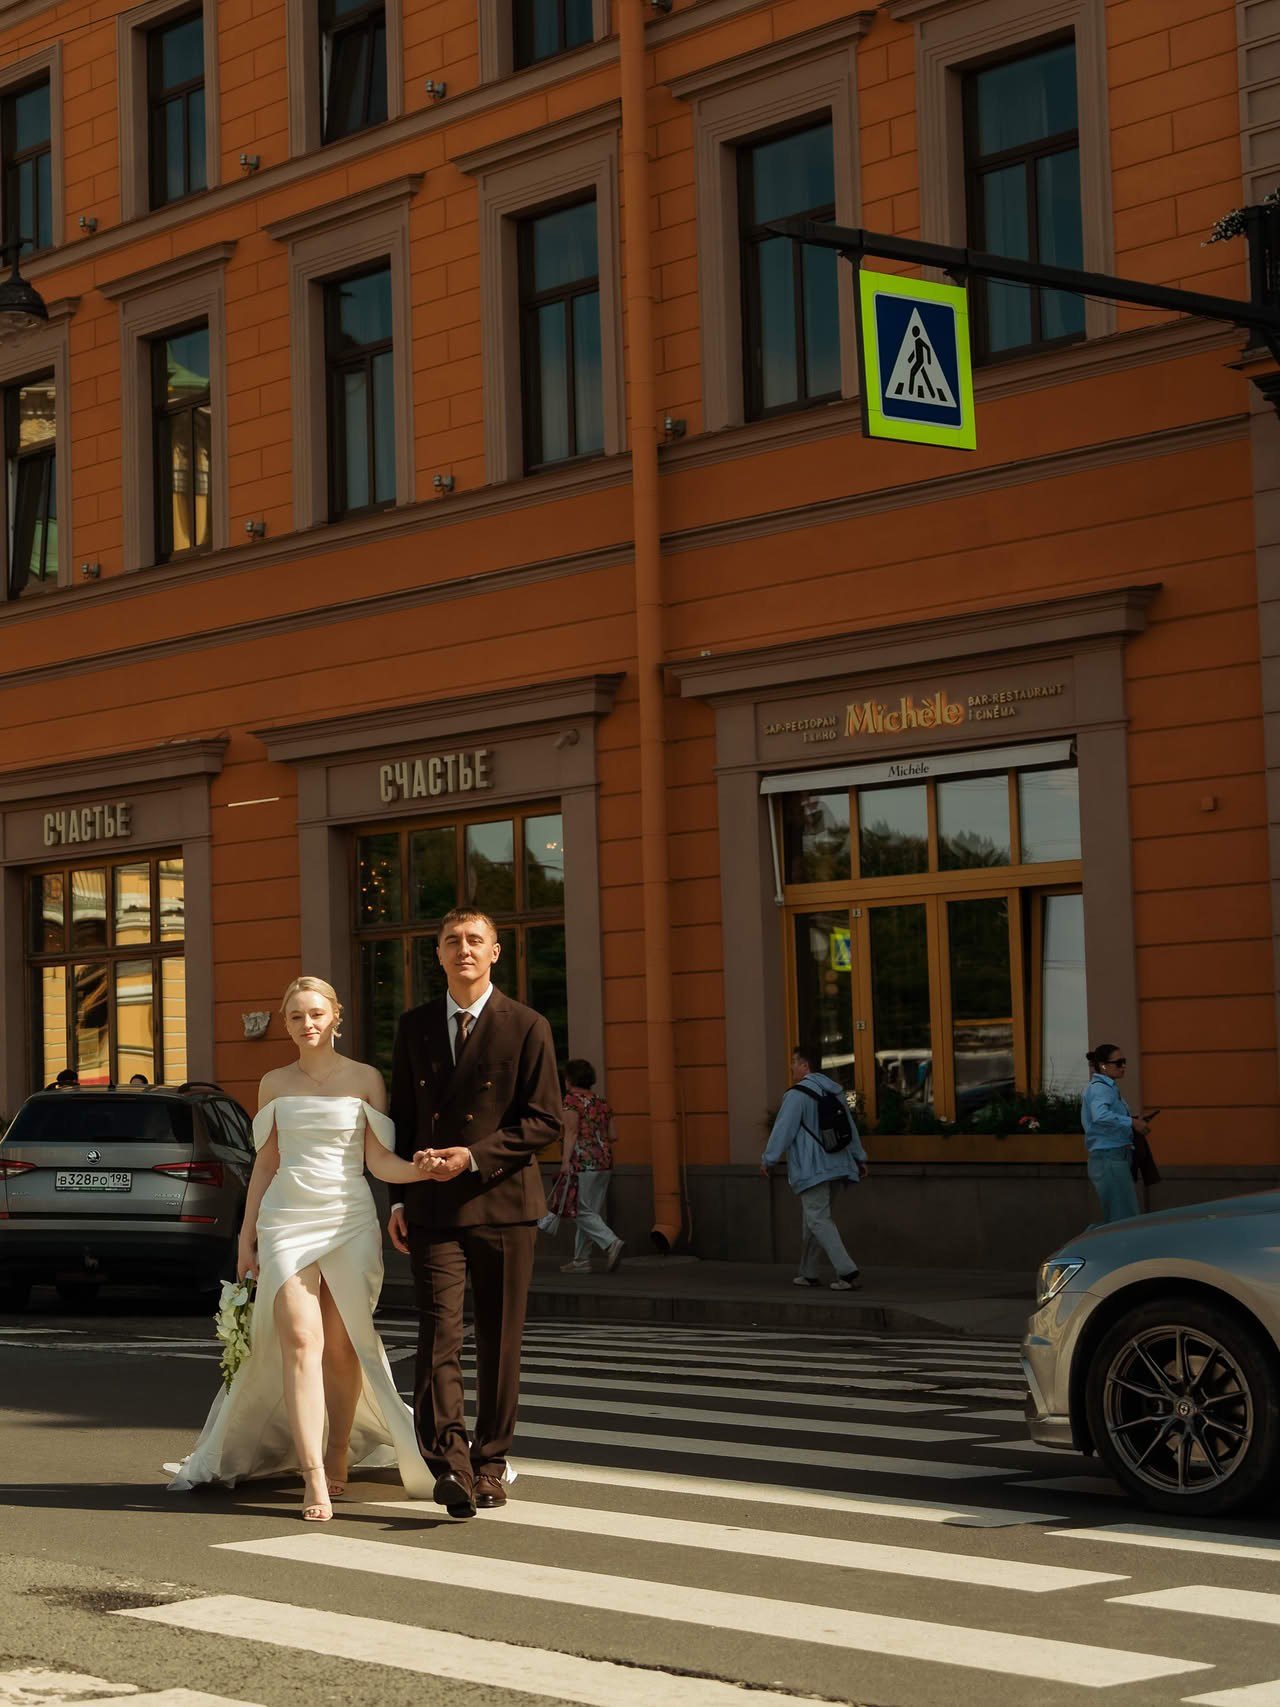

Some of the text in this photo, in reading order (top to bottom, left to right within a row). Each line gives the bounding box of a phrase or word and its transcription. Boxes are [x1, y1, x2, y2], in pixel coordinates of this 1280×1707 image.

[843, 692, 963, 737] Michèle
[967, 684, 1063, 706] BAR-RESTAURANT
[379, 749, 488, 802] СЧАСТЬЕ
[43, 802, 131, 847] СЧАСТЬЕ
[110, 1173, 128, 1183] 198
